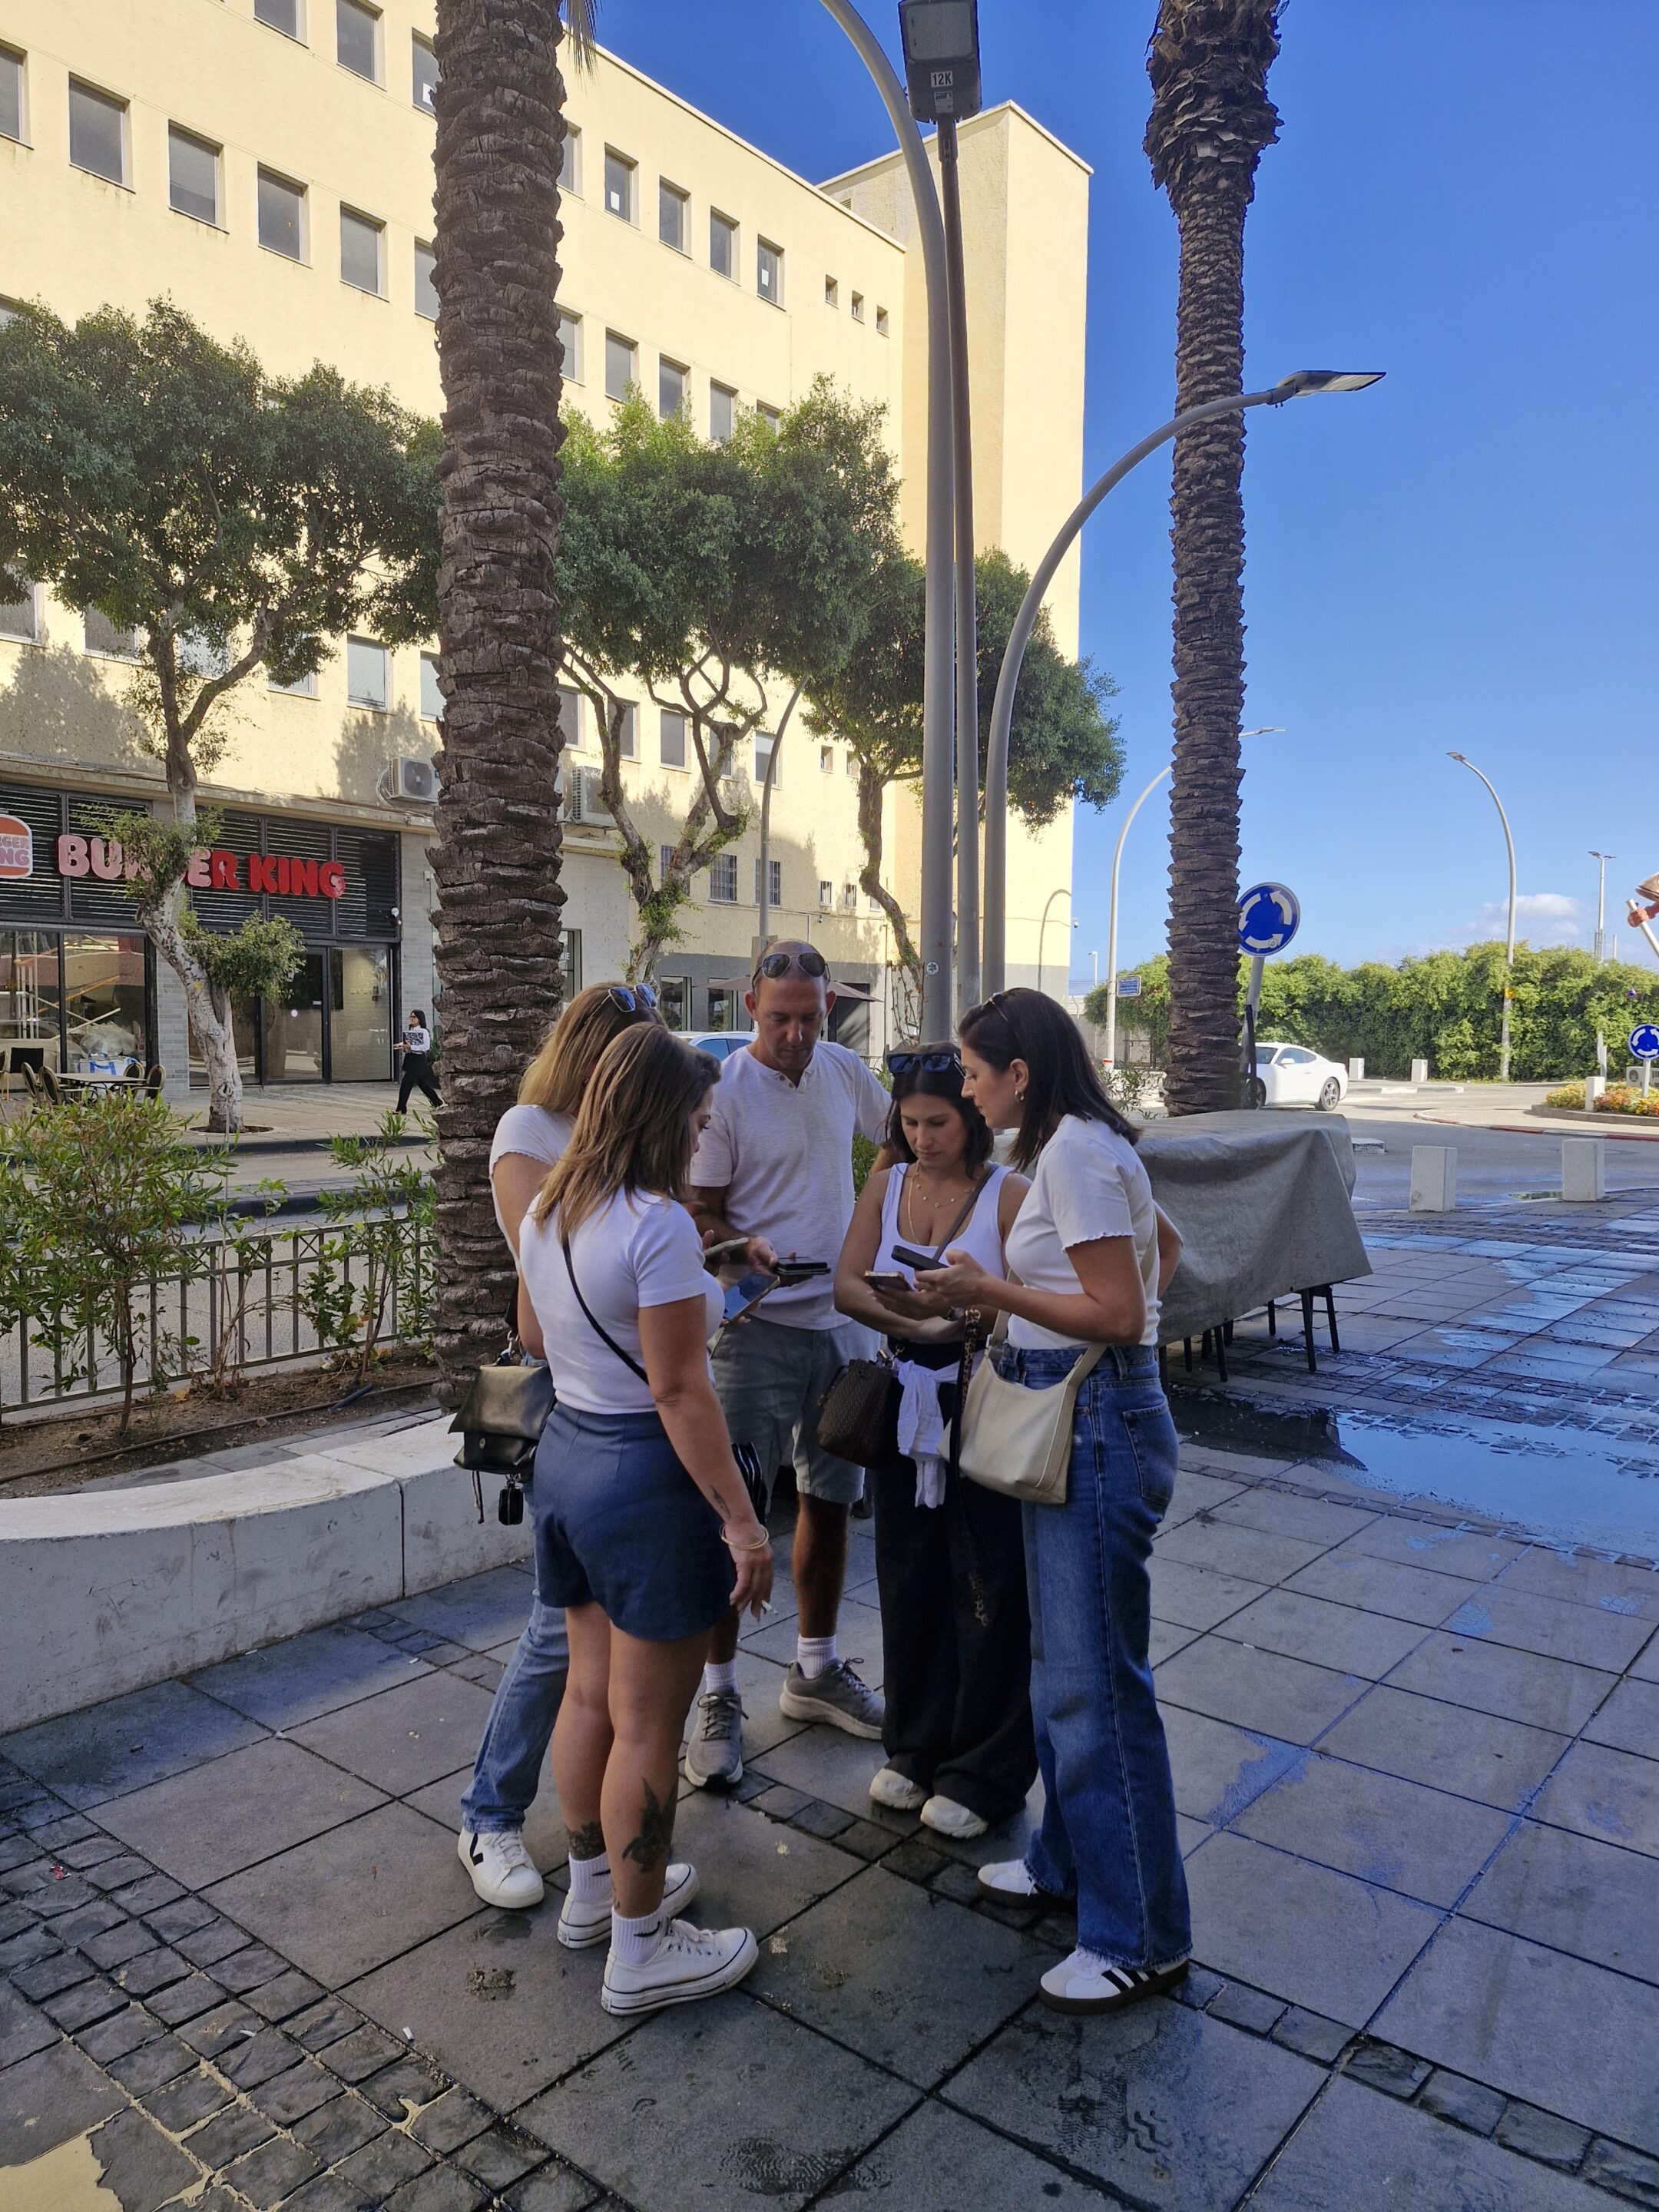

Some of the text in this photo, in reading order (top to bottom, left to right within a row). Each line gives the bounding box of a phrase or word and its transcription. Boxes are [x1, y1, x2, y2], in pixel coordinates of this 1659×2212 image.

[932, 72, 952, 85] 12K
[0, 836, 29, 849] GER
[248, 853, 346, 898] KING
